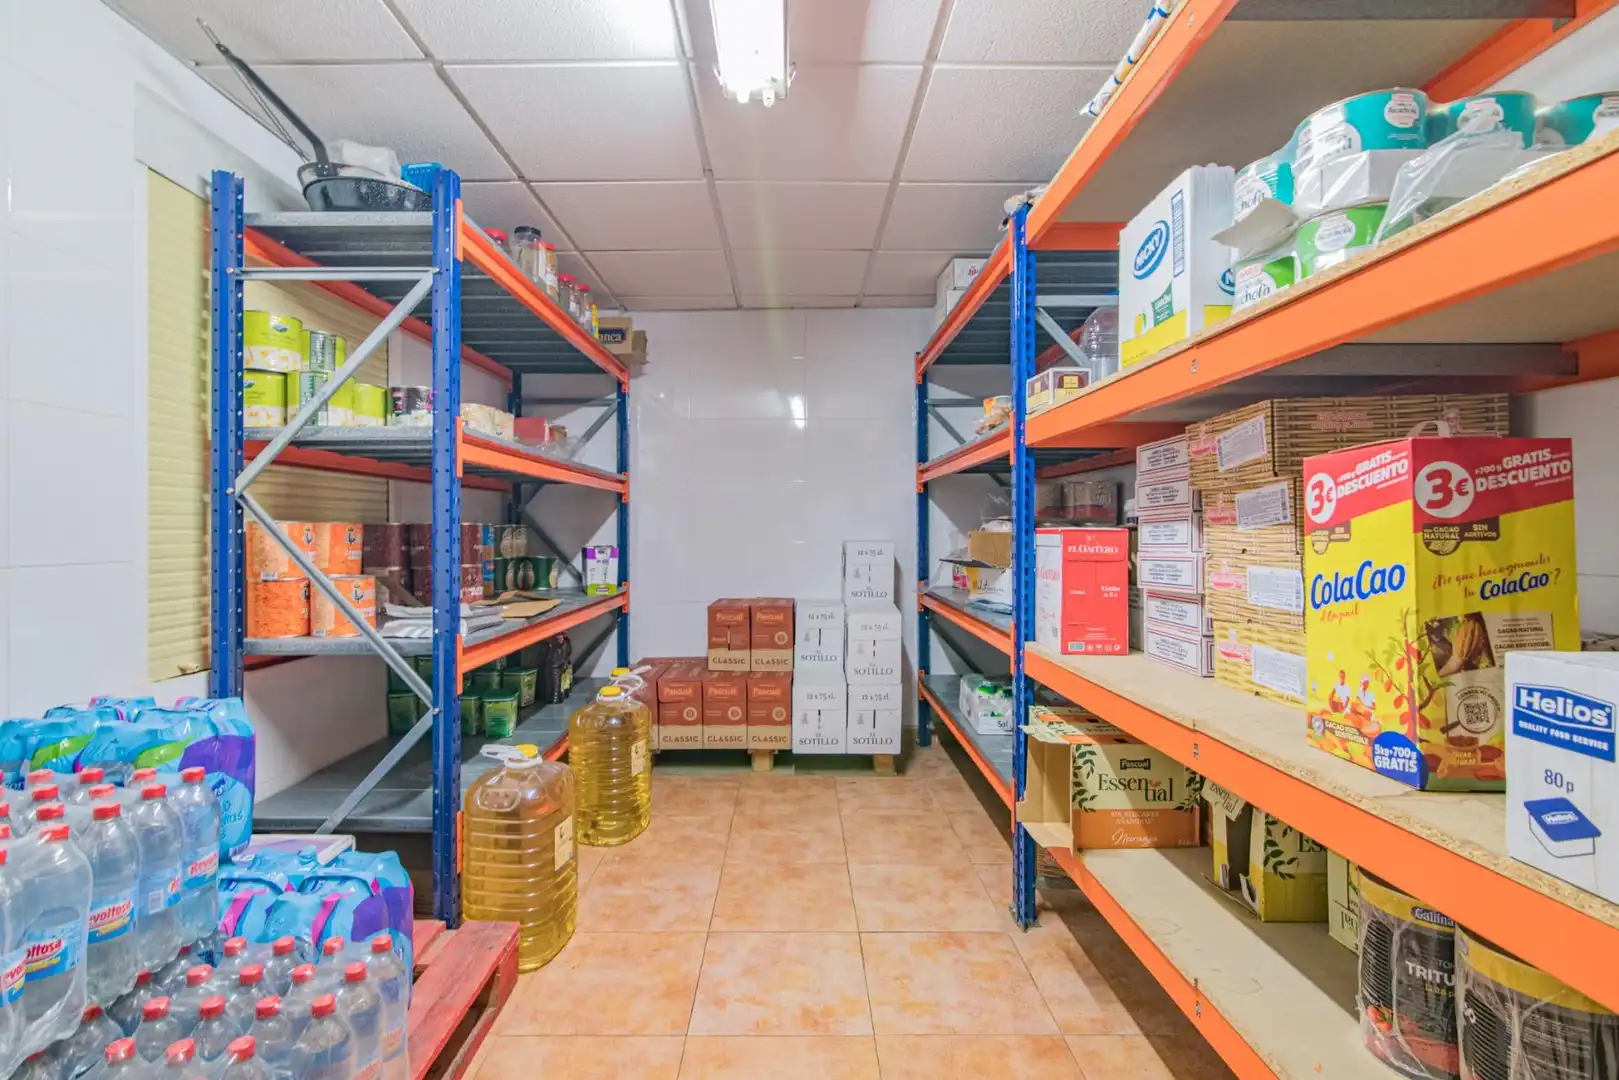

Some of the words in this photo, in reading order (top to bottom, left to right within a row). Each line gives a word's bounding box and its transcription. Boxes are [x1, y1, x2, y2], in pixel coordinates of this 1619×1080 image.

[1502, 448, 1551, 469] GRATIS
[1336, 458, 1408, 499] DESCUENTO
[1475, 459, 1572, 492] DESCUENTO
[1424, 532, 1460, 540] NATURAL
[1311, 560, 1405, 610] ColaCao
[1480, 571, 1549, 600] ColaCao
[712, 657, 746, 665] CLASSIC
[853, 667, 893, 675] SOTILLO
[1519, 688, 1609, 728] Helios
[663, 735, 699, 743] CLASSIC
[707, 735, 743, 743] CLASSIC
[752, 735, 788, 743] CLASSIC
[799, 737, 839, 745] SOTILLO
[853, 737, 893, 745] SOTILLO
[1518, 720, 1548, 735] QUALITY
[1550, 729, 1570, 741] FOOD
[1573, 733, 1609, 751] SERVICE
[1121, 760, 1150, 769] Pascual
[1374, 756, 1418, 773] GRATIS
[1544, 768, 1563, 789] 80
[1566, 780, 1574, 793] p
[1415, 908, 1456, 926] Gallina
[1405, 961, 1455, 987] TRITU
